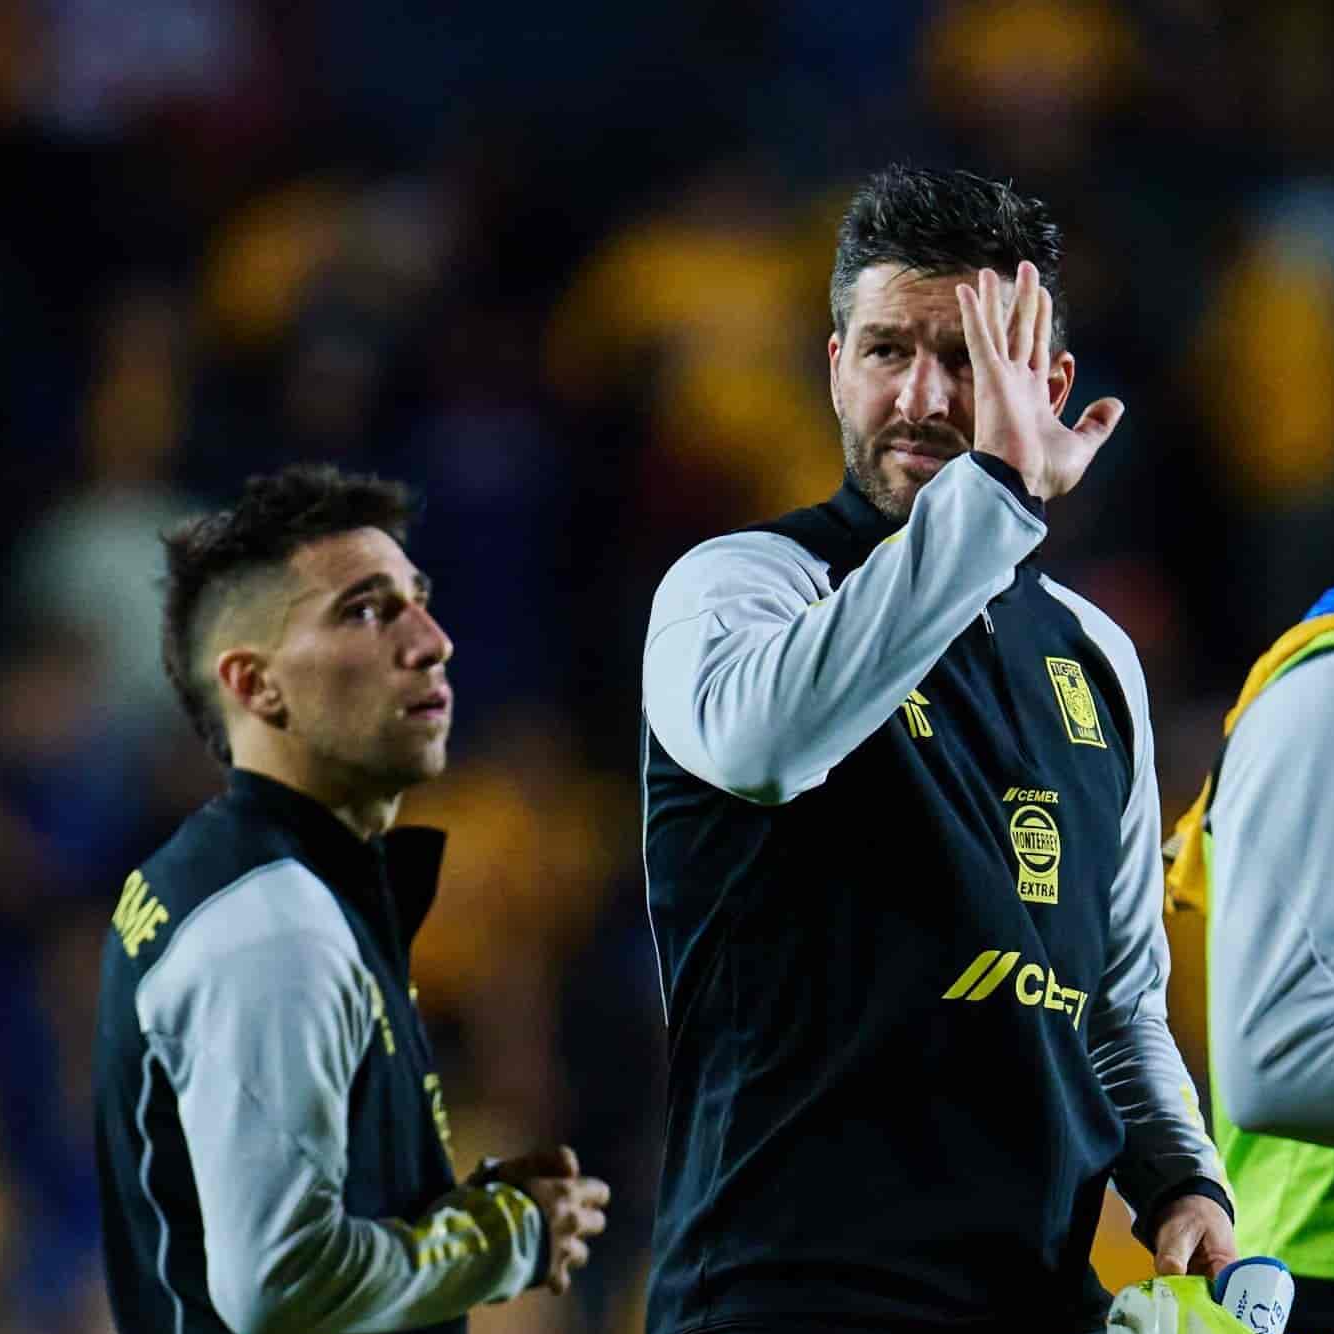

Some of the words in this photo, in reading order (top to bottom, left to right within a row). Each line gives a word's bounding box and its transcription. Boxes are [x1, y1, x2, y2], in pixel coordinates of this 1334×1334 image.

[1017, 789, 1059, 804] CEMEX
[1012, 831, 1058, 851] MONTERREY
[1020, 881, 1055, 897] EXTRA
